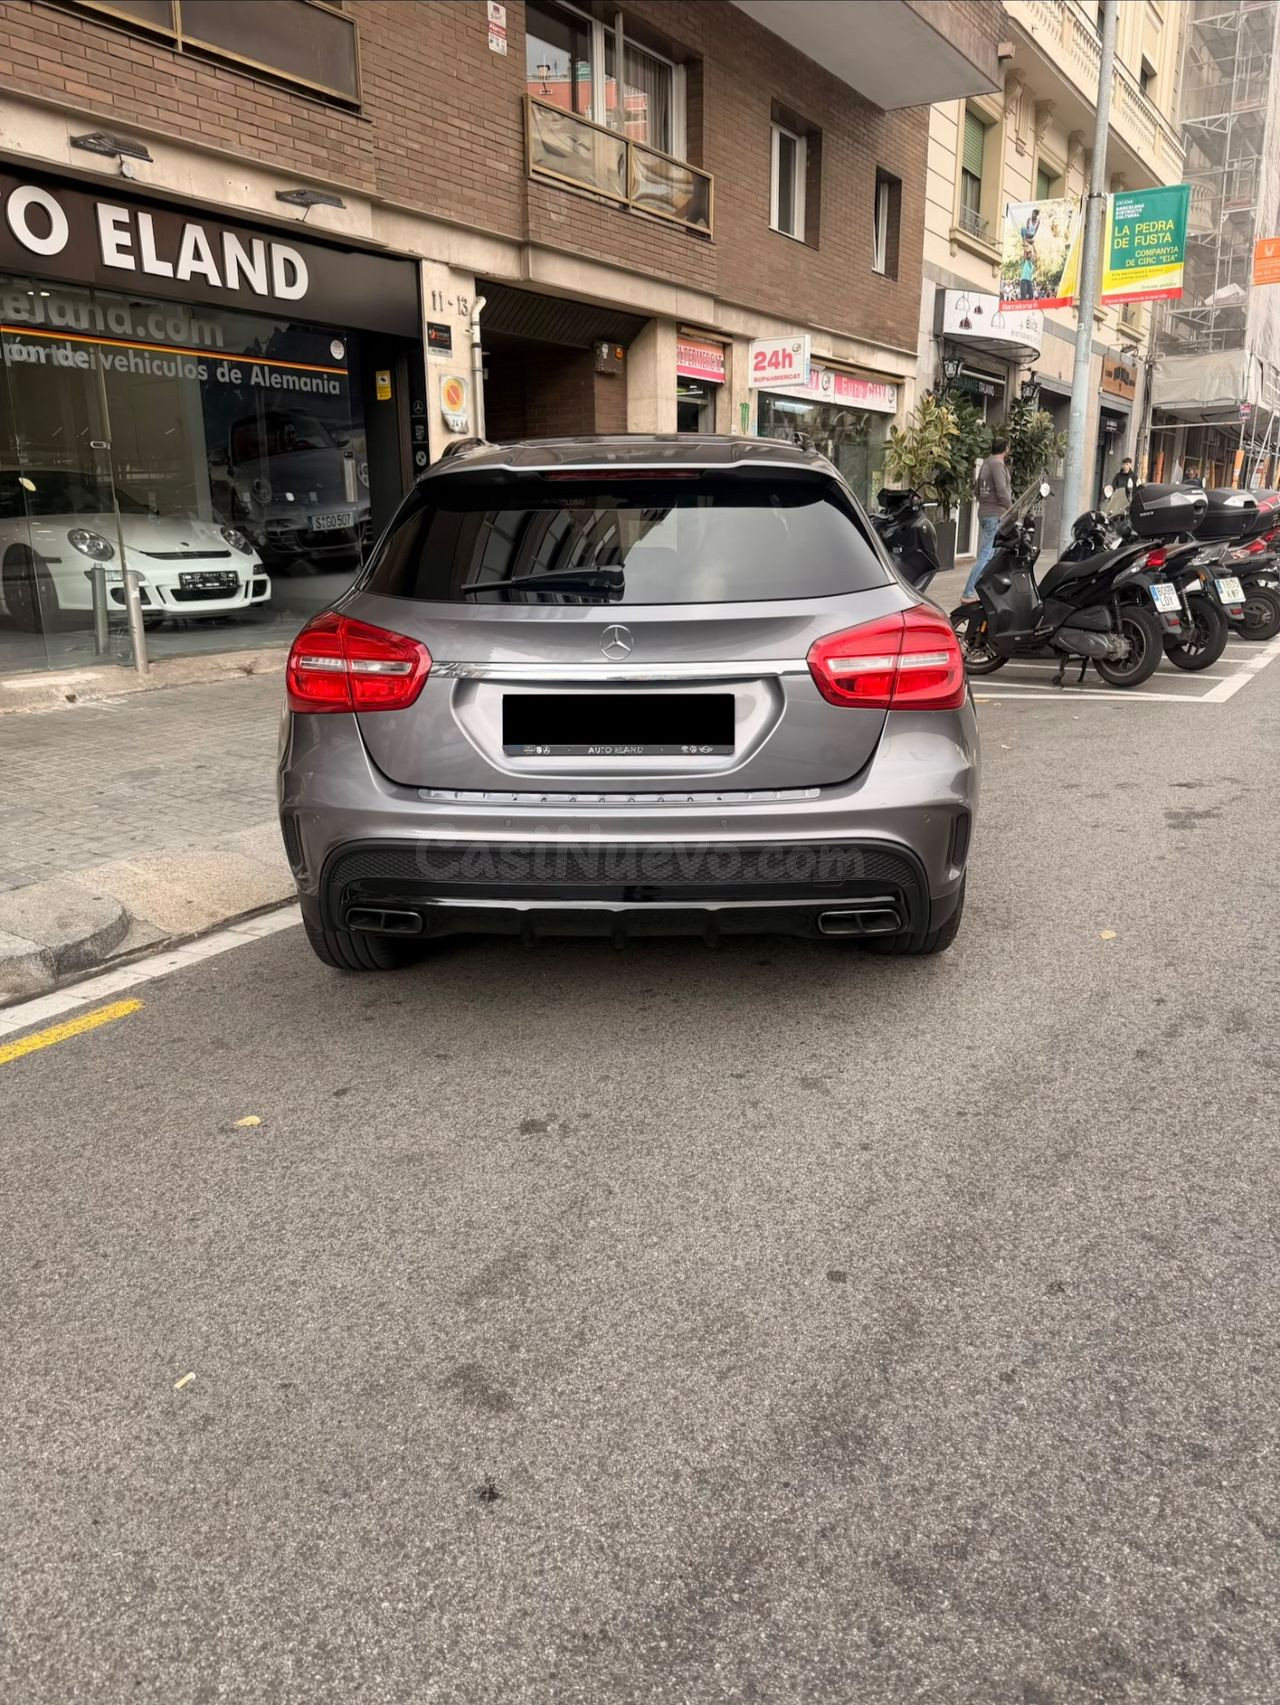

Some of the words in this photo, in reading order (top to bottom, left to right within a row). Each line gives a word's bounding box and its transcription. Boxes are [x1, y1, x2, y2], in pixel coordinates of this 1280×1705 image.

[1115, 225, 1130, 237] LA
[1135, 219, 1174, 234] PEDRA
[6, 184, 69, 256] O
[95, 202, 310, 301] ELAND
[1114, 237, 1129, 249] DE
[1134, 232, 1172, 247] FUSTA
[1135, 245, 1179, 258] COMPANYIA
[1125, 259, 1136, 267] DE
[1138, 256, 1157, 266] CIRC
[753, 348, 793, 371] 24h
[101, 349, 208, 381] vehiculos
[216, 351, 242, 384] de
[250, 365, 341, 395] Alemania
[588, 746, 612, 754] AUTO
